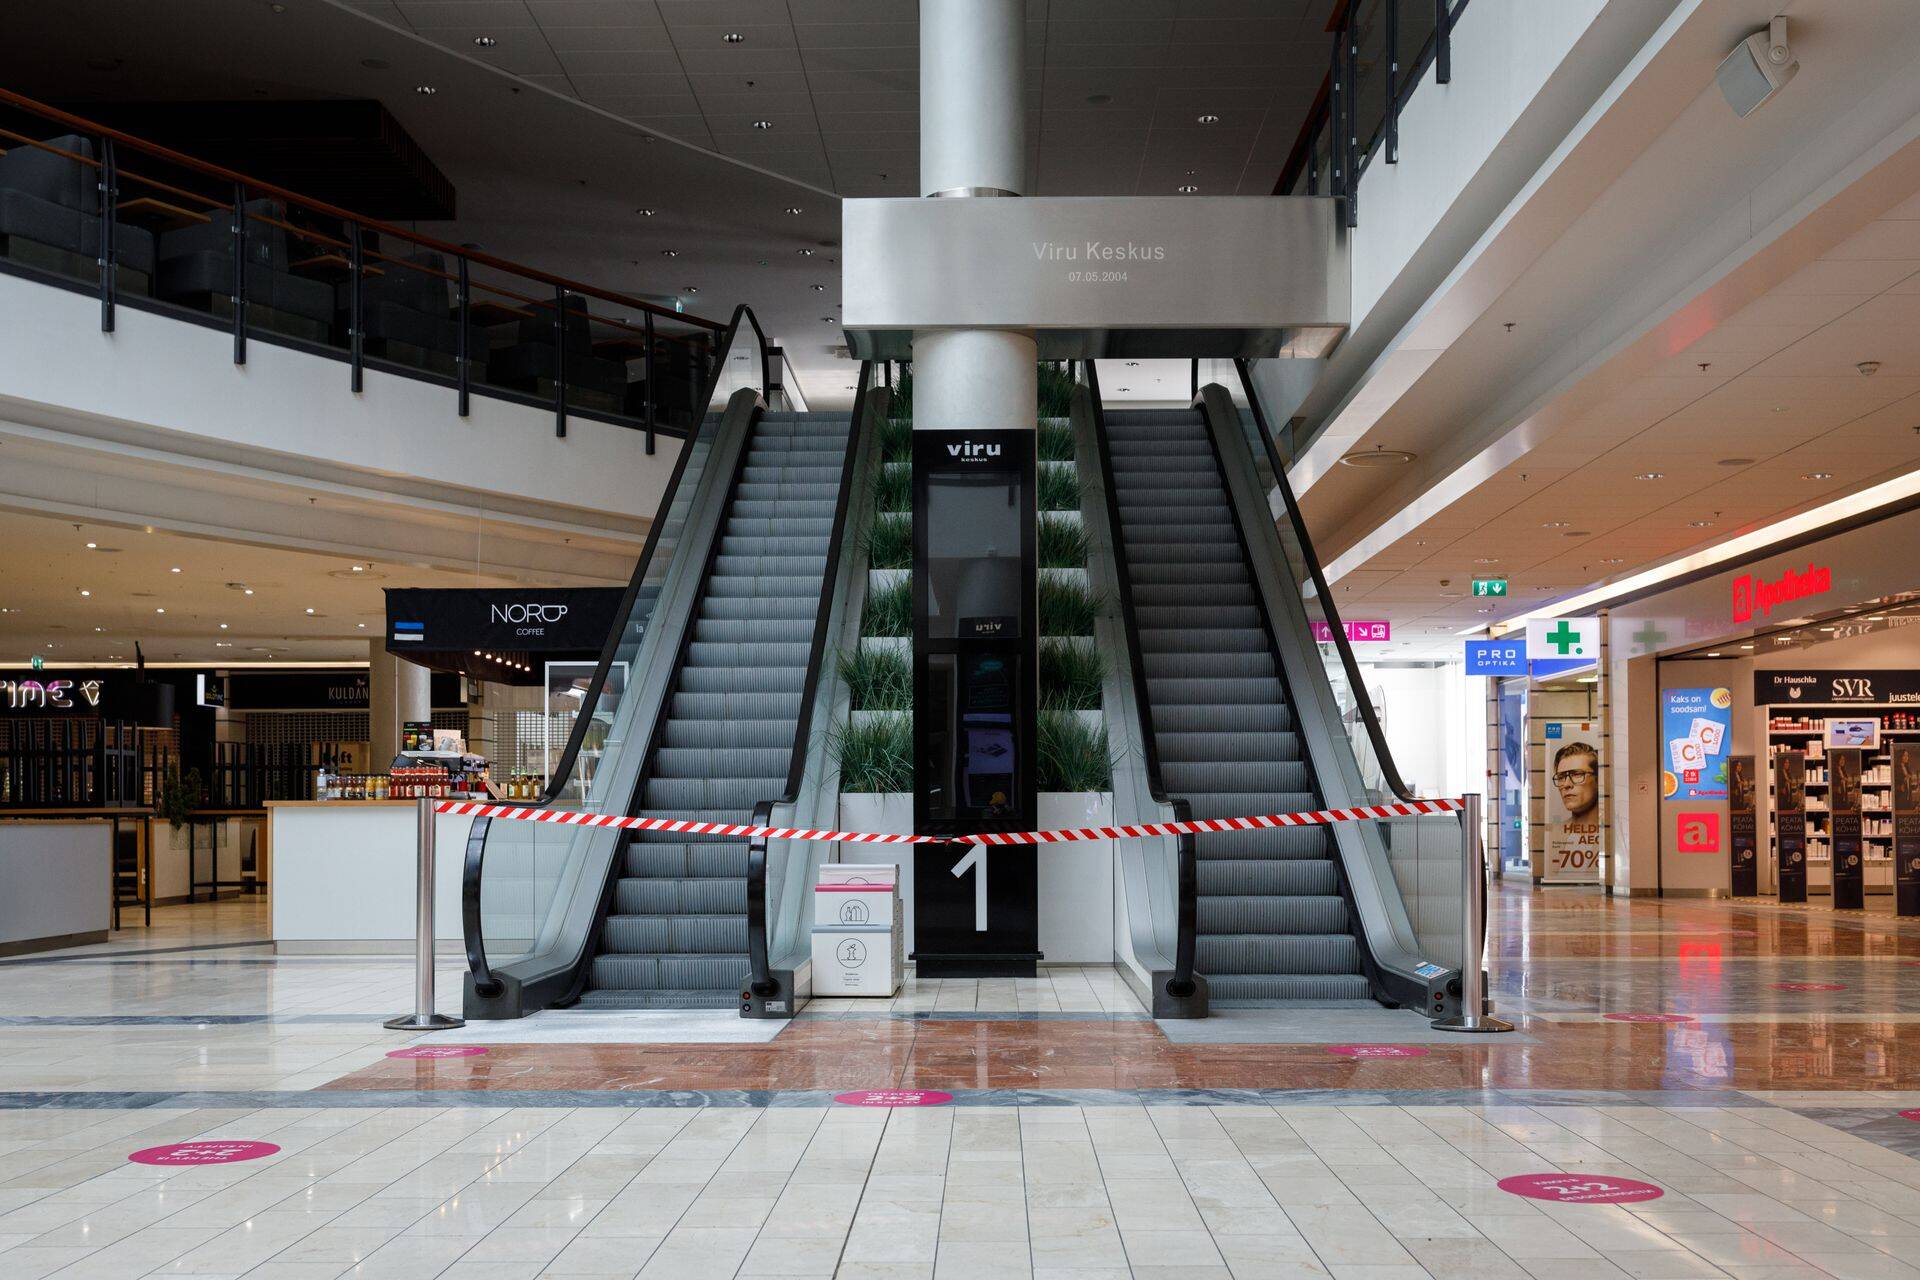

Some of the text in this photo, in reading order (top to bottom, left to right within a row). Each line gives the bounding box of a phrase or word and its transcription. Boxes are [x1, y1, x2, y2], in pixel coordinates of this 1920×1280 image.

[1033, 242, 1165, 260] Viru Keskus
[1068, 271, 1128, 282] 07.05.2004
[947, 440, 1001, 456] viru
[1754, 563, 1832, 616] Apotheka
[516, 628, 545, 636] COFFEE
[1477, 649, 1516, 659] PRO
[1784, 676, 1817, 684] Hauschka
[1832, 678, 1874, 697] SVR
[0, 680, 74, 708] IME
[1671, 695, 1689, 703] Kaks
[1671, 705, 1707, 714] soodsam!
[1700, 727, 1714, 744] C
[1682, 744, 1696, 761] C
[951, 845, 987, 931] 1
